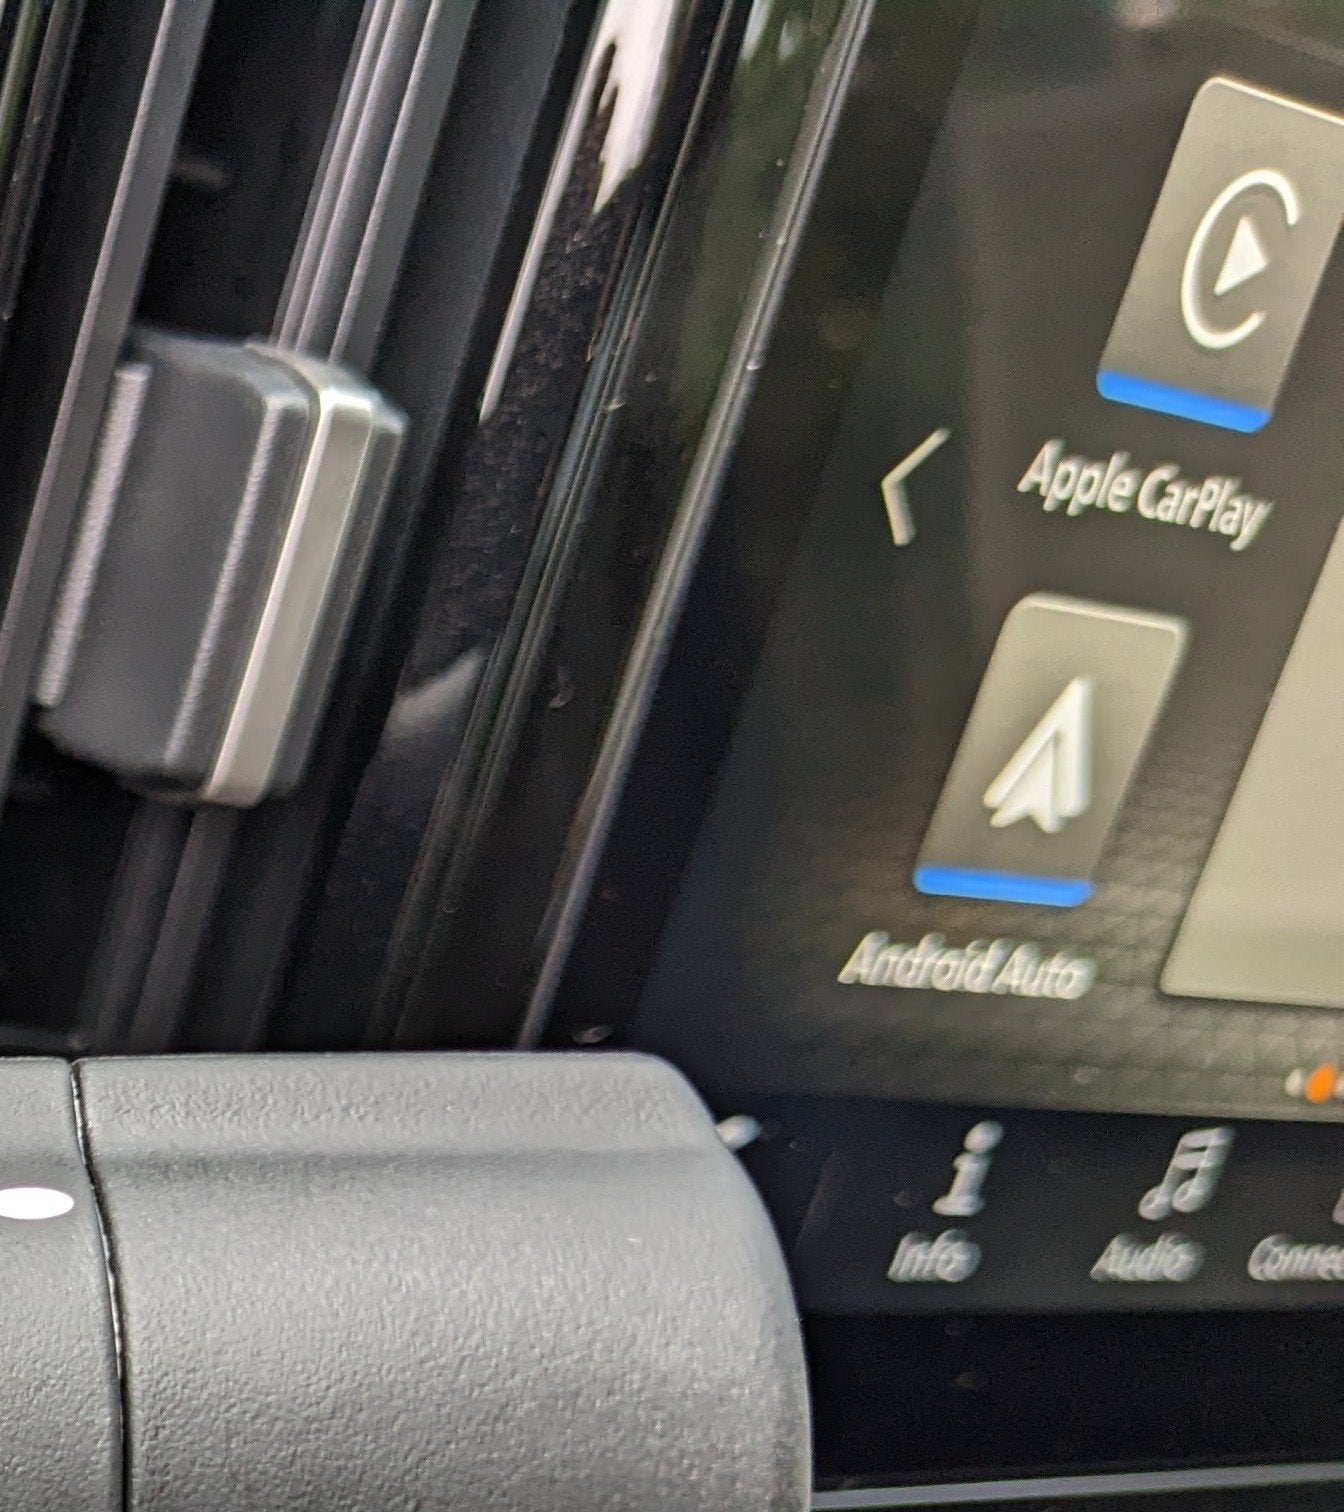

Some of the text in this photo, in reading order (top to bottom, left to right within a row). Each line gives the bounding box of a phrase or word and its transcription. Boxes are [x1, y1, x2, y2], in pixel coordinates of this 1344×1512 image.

[1017, 438, 1274, 551] Apple CarPlay
[837, 930, 1096, 1000] Android Auto
[887, 1230, 982, 1283] Info
[1090, 1232, 1204, 1283] Audio
